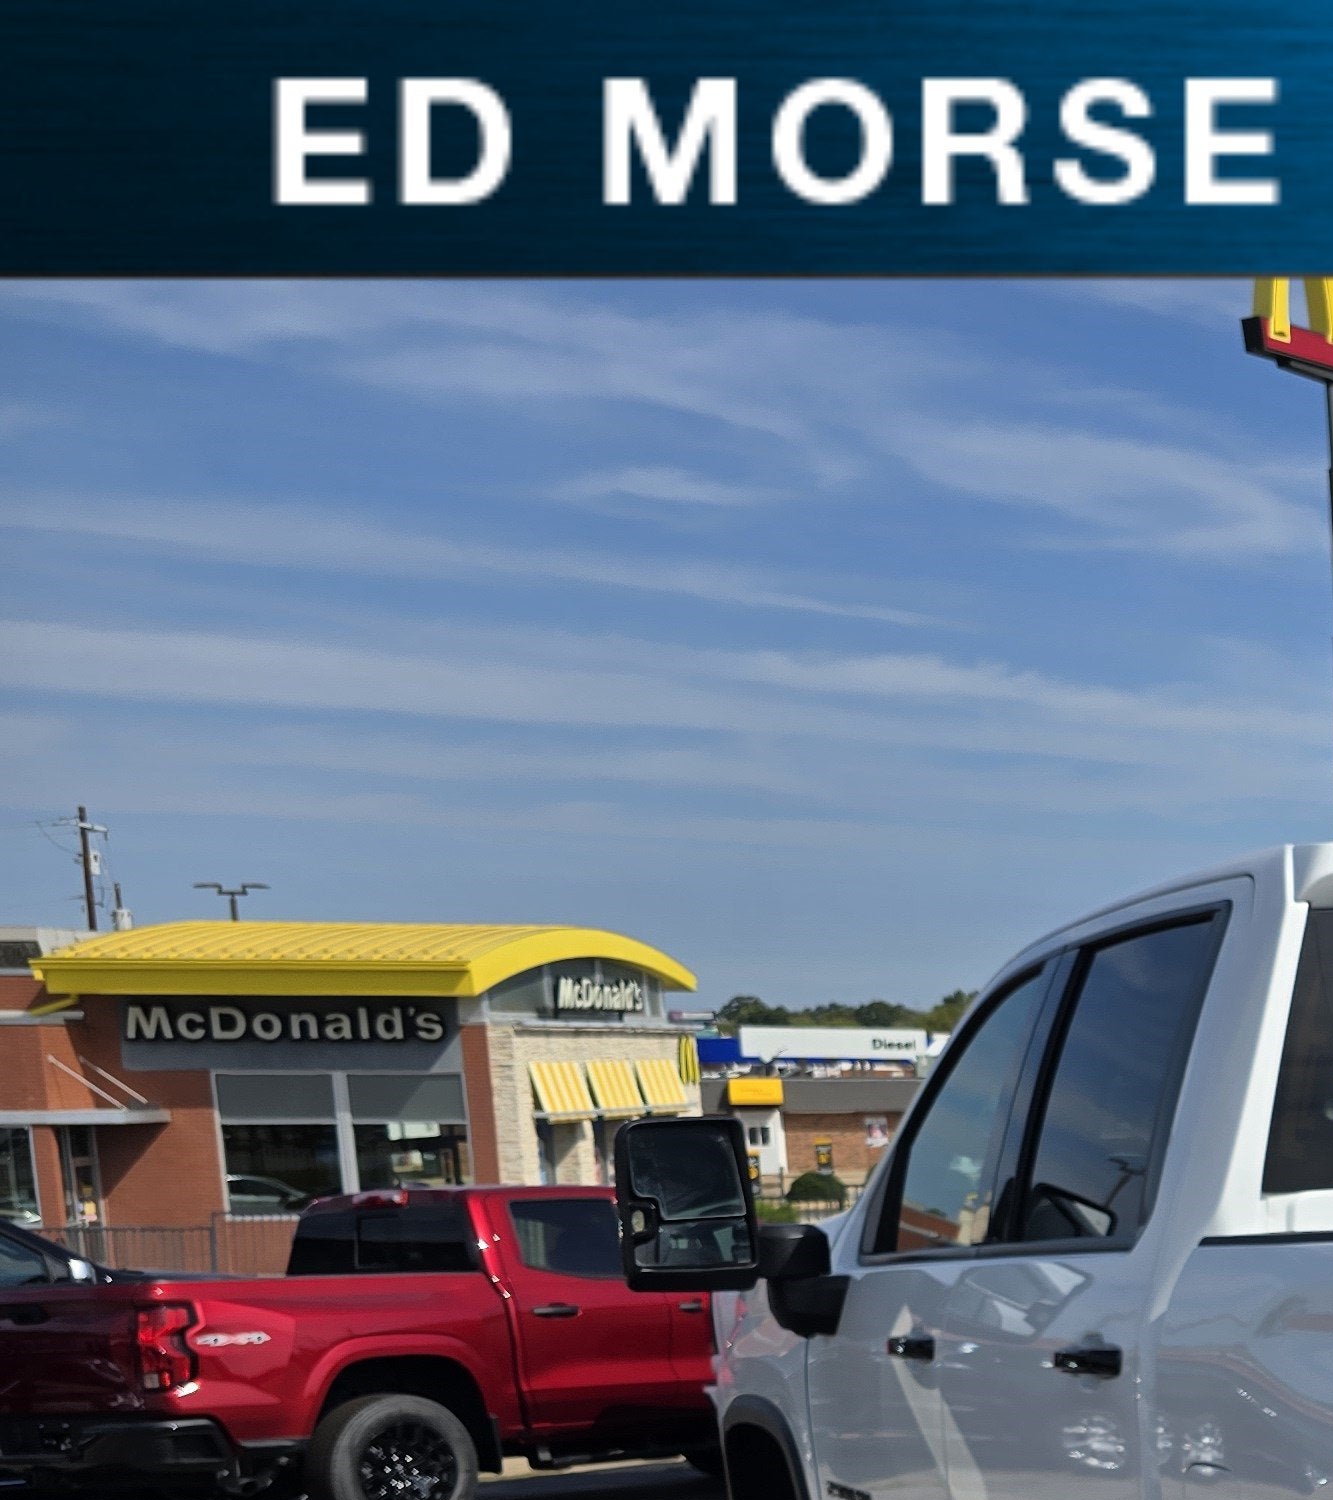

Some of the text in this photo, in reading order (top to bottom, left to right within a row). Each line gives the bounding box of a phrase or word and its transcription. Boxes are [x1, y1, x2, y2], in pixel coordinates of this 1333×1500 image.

[557, 976, 643, 1012] McDonald's
[126, 1005, 445, 1041] McDonald's
[871, 1038, 916, 1051] Diesel
